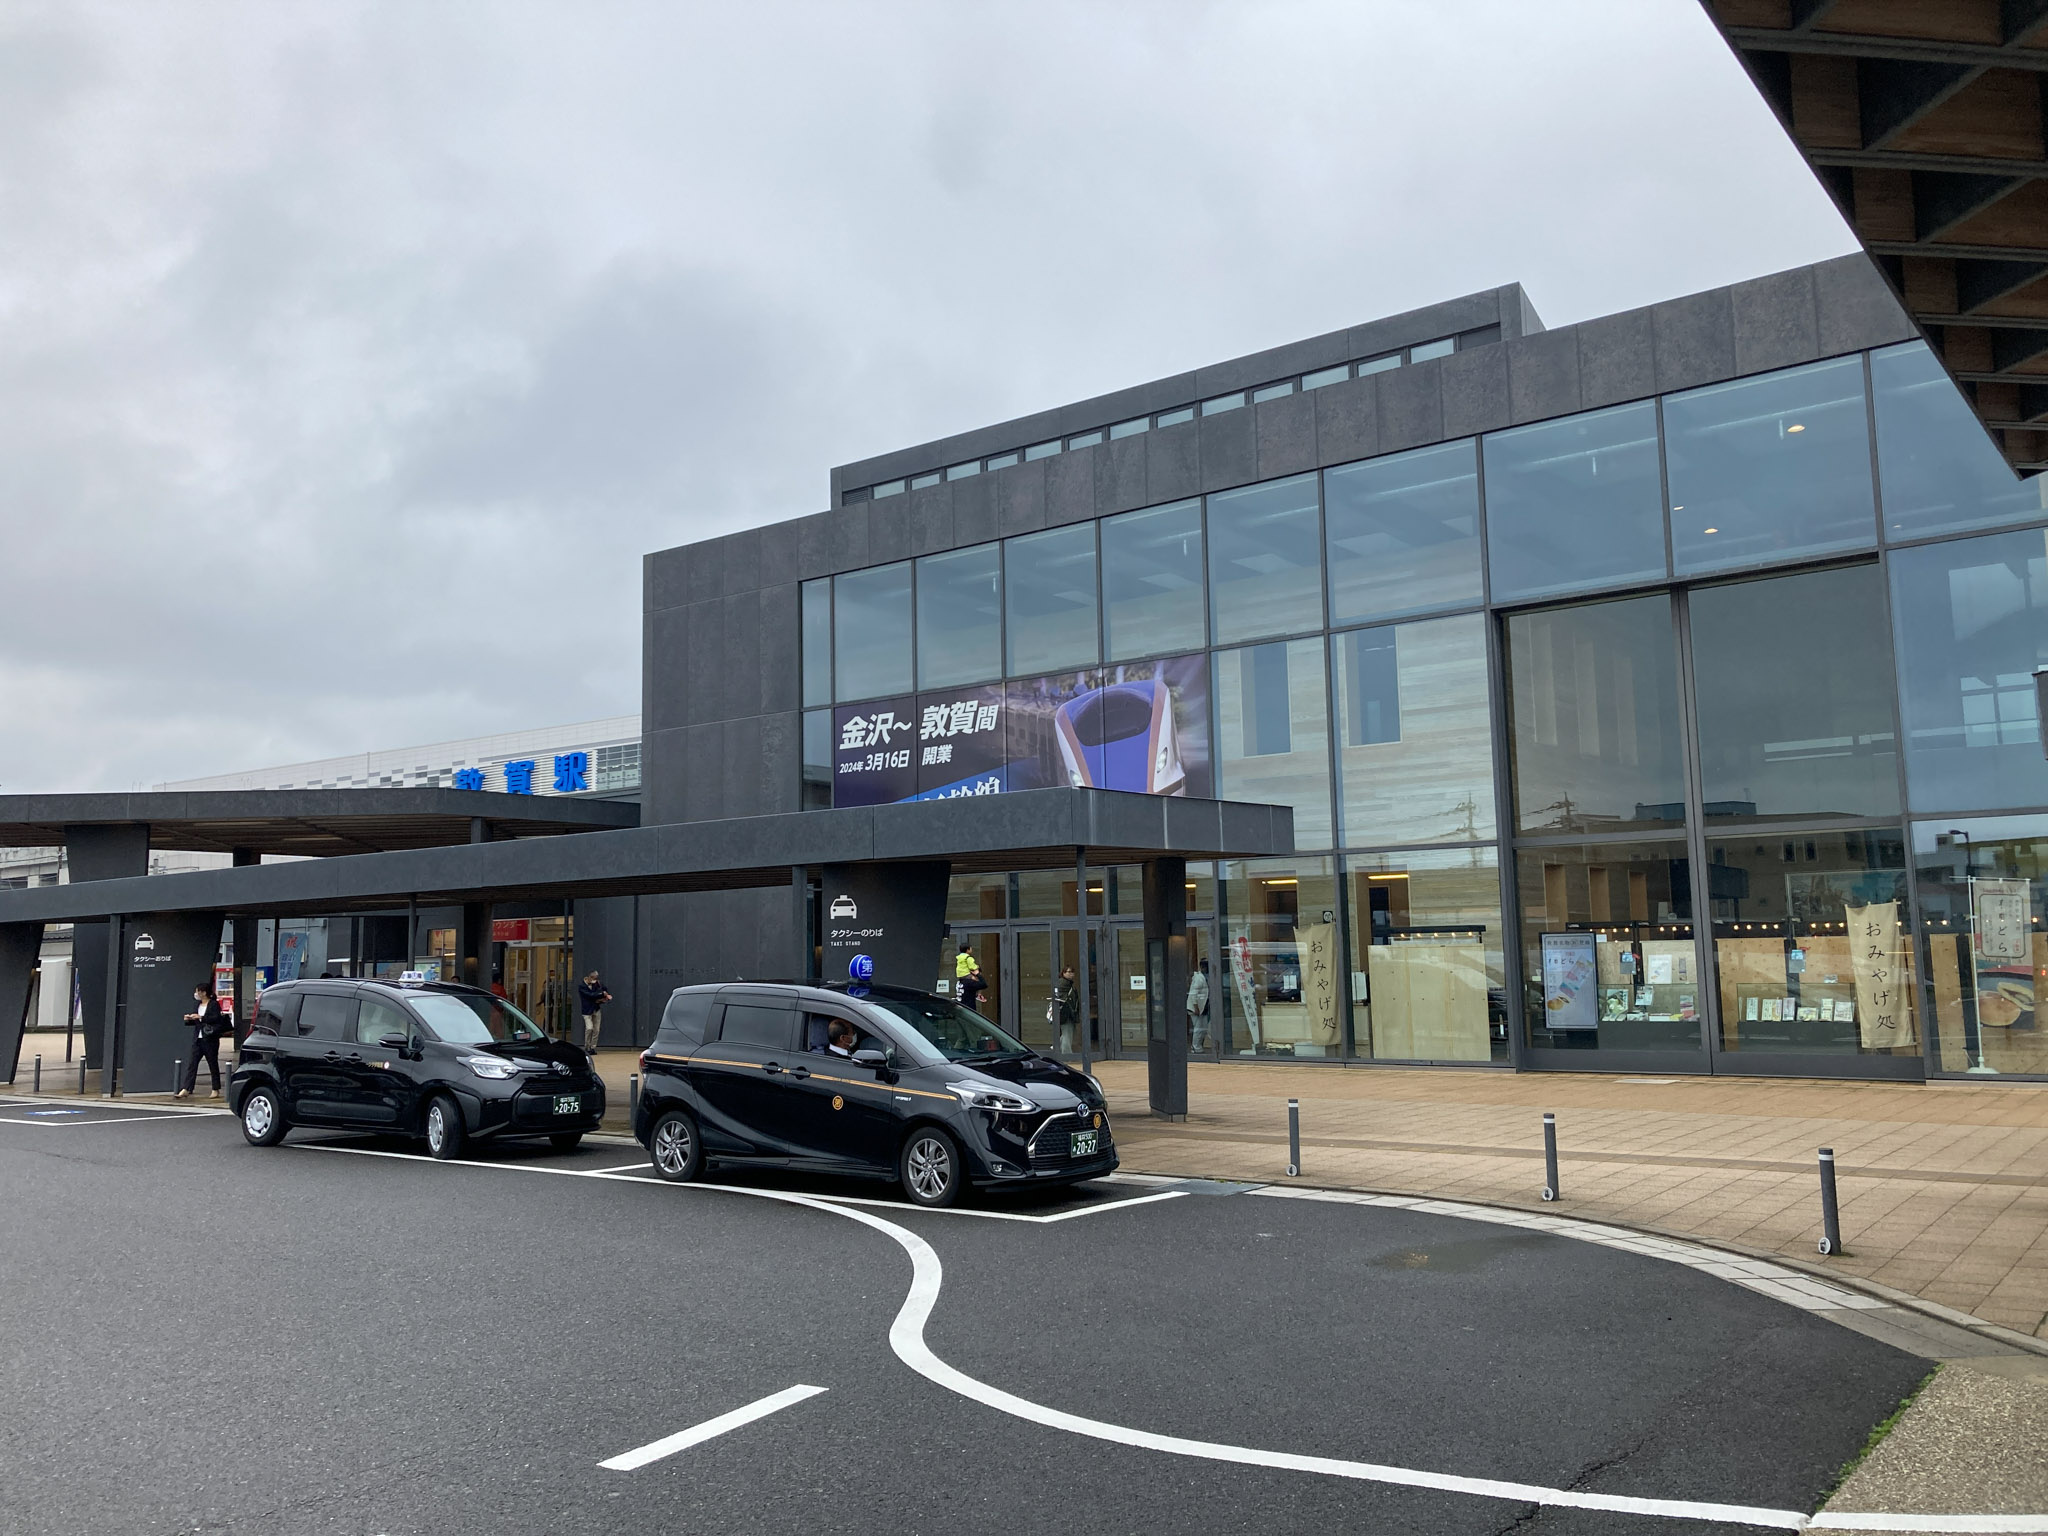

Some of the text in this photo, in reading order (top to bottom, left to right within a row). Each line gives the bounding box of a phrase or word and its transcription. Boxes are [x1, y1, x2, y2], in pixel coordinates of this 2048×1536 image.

[455, 752, 588, 795] 敦賀駅
[922, 744, 953, 766] 開業
[831, 928, 883, 938] タクシーのりば
[1311, 940, 1337, 1031] おみやげ処
[1866, 922, 1896, 1030] おみやげ処
